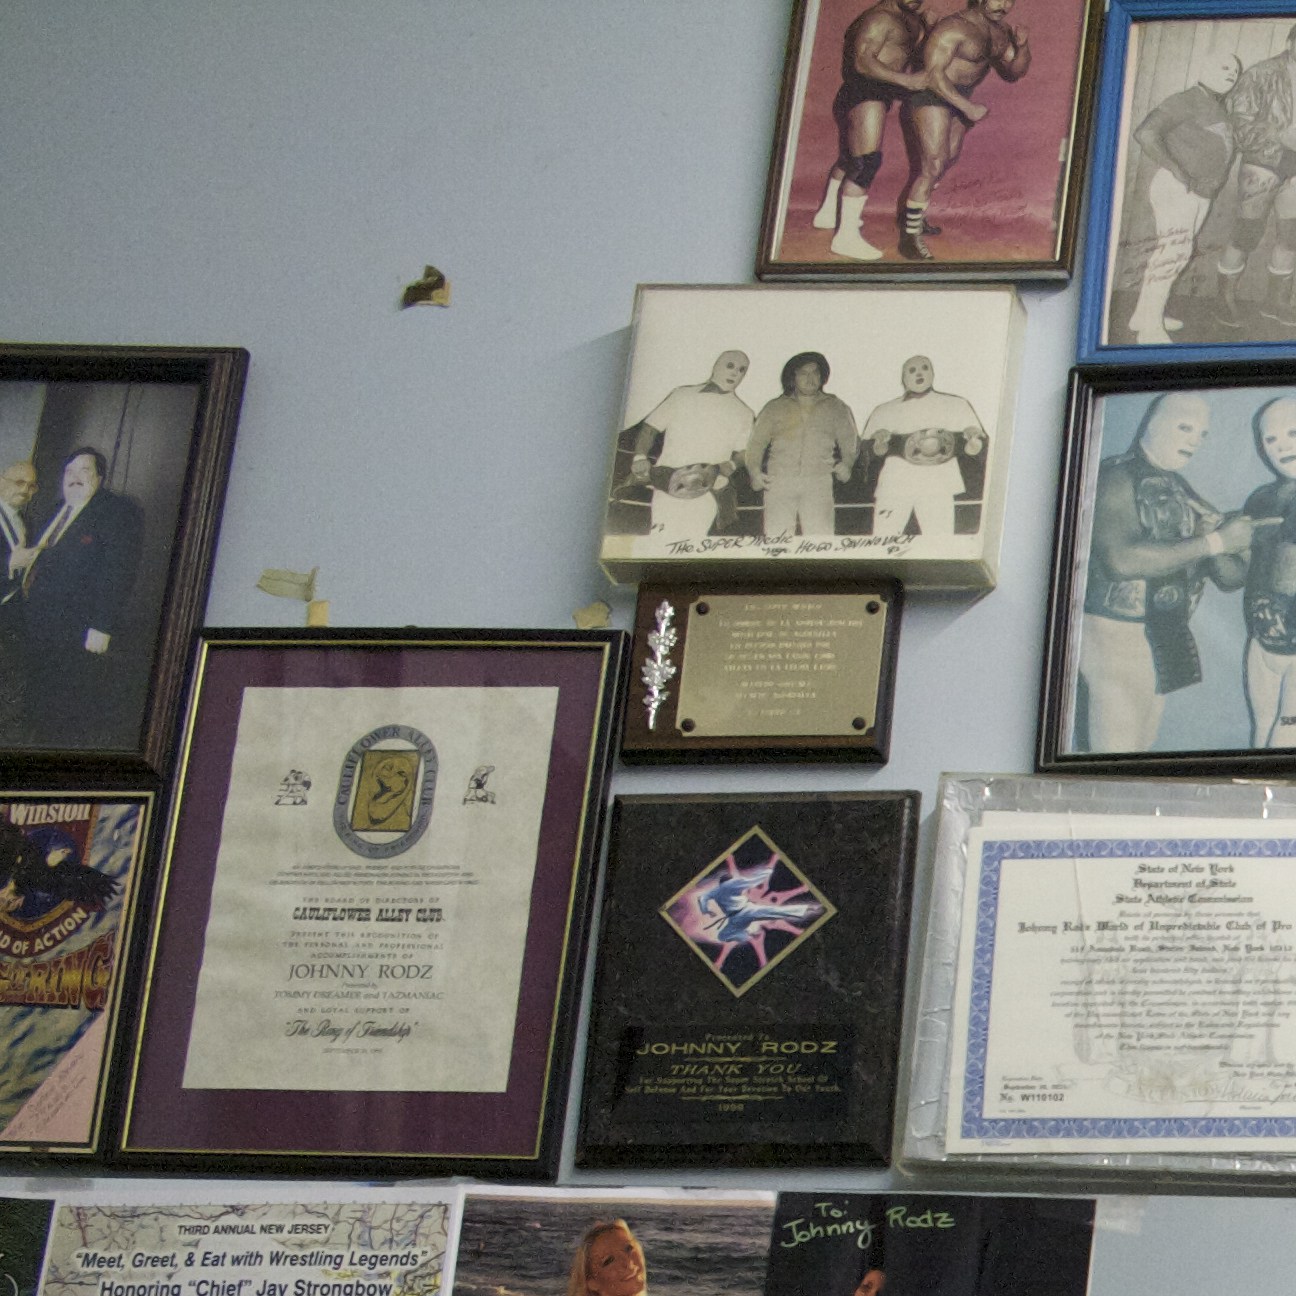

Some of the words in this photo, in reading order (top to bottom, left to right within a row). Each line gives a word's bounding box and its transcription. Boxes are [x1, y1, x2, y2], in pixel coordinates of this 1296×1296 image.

[292, 907, 371, 922] CAULIFLOWER
[375, 907, 413, 923] ALLEY
[12, 940, 29, 955] OF
[34, 906, 89, 953] ACTION
[287, 963, 369, 981] JOHNNY
[378, 963, 433, 980] RODZ
[636, 1041, 742, 1055] JOHNNY
[761, 1041, 839, 1054] RODZ
[669, 1064, 744, 1075] THANK
[757, 1063, 802, 1075] YOU
[177, 1223, 210, 1236] THIRD
[212, 1223, 257, 1236] ANNUAL
[259, 1223, 286, 1236] NEW
[287, 1223, 332, 1236] JERSEY
[780, 1217, 876, 1250] Johnny
[886, 1206, 956, 1229] Rodz
[132, 1251, 180, 1271] Greet,
[184, 1252, 195, 1267] &
[200, 1251, 226, 1267] Eat
[230, 1250, 262, 1267] with
[268, 1250, 344, 1271] Wrestling
[348, 1248, 430, 1271] Legends"
